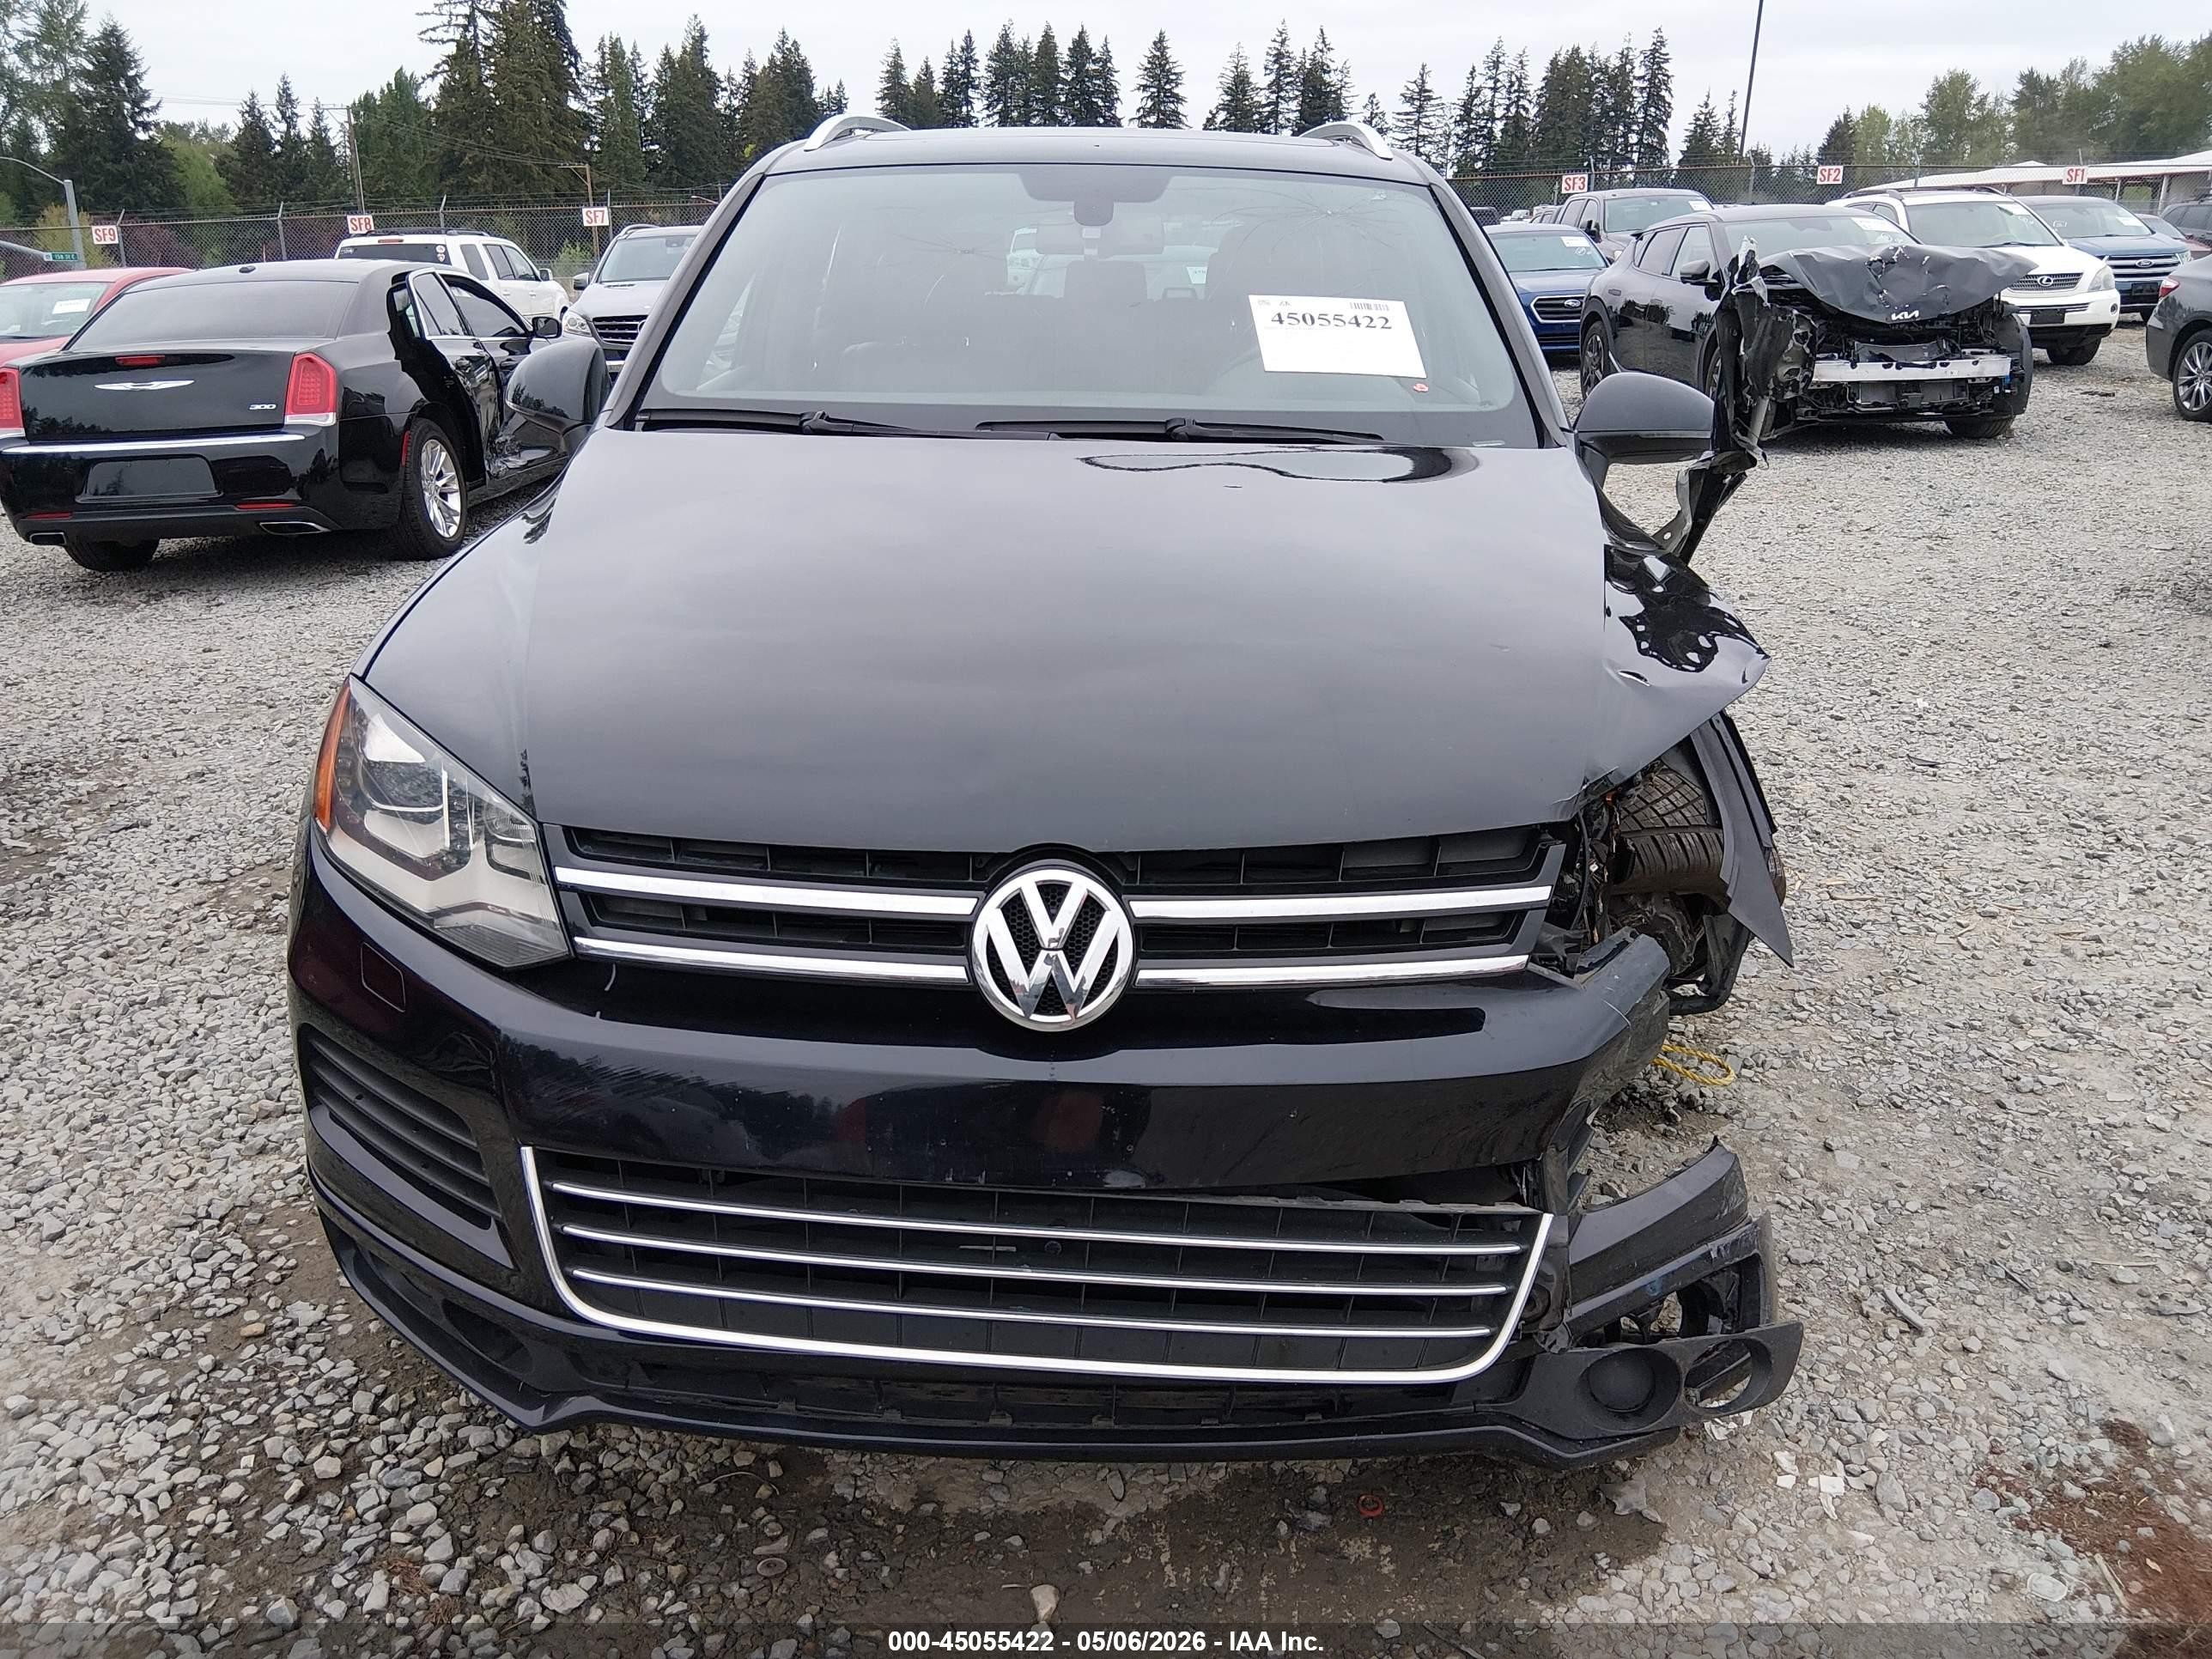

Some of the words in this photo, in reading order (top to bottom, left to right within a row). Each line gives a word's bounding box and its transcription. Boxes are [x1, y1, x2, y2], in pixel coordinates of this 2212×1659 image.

[1819, 167, 1841, 182] SF2
[2066, 167, 2085, 182] SF1
[1564, 176, 1586, 191] SF3
[349, 216, 372, 232] SF8
[585, 210, 605, 224] SF7
[94, 228, 116, 242] SF9
[1271, 311, 1393, 330] 45055422
